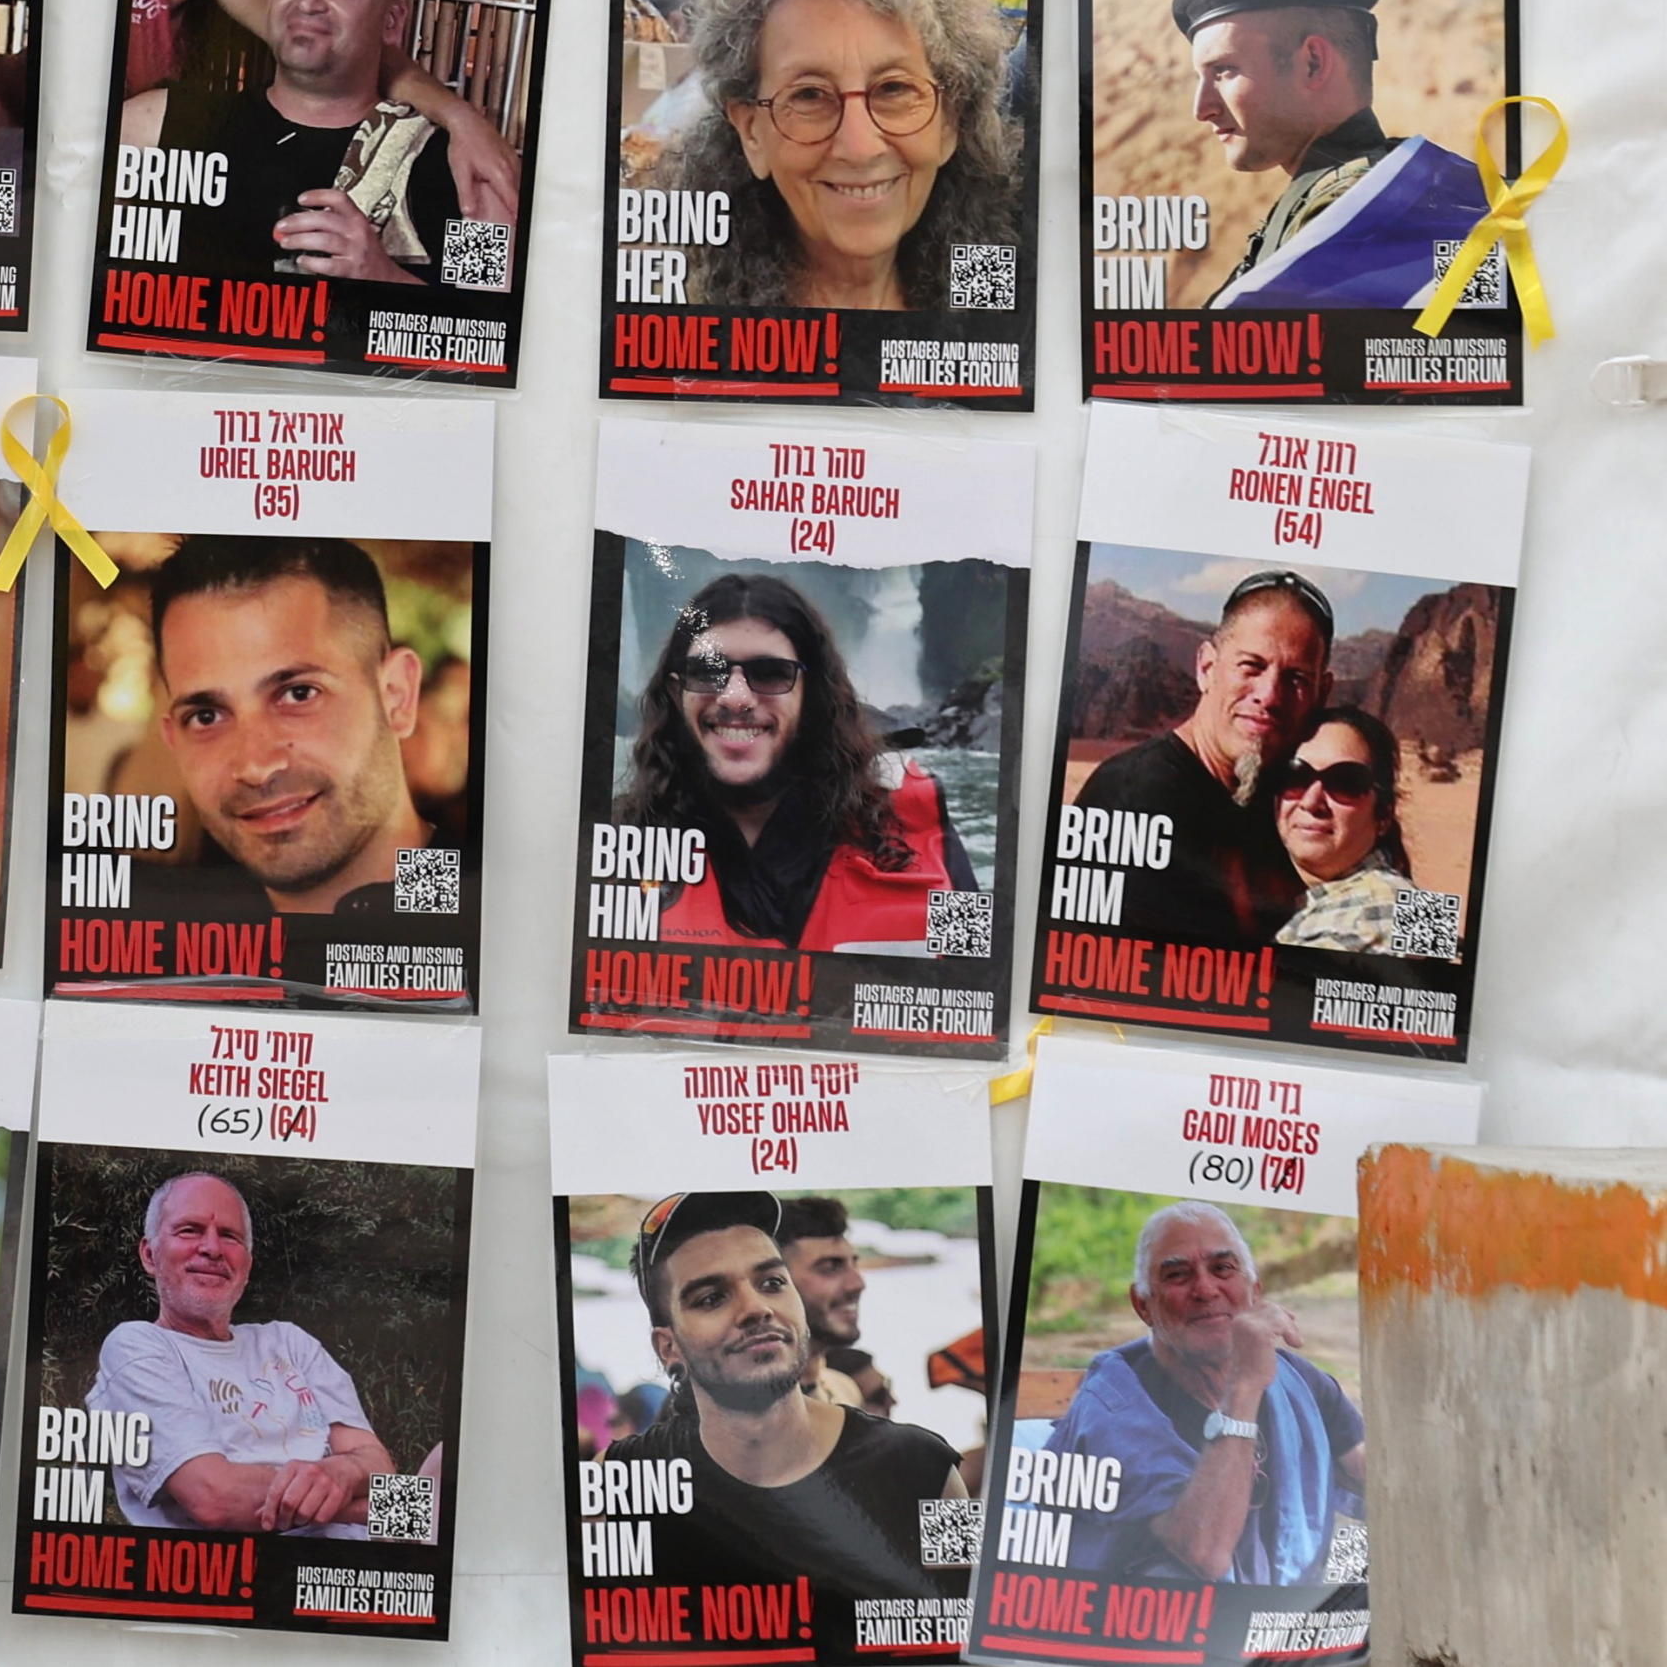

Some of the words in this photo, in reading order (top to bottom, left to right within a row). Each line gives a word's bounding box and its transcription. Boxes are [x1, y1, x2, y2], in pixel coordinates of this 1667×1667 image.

[617, 189, 730, 246] BRING
[616, 249, 687, 304] HER
[615, 313, 718, 371] HOME
[731, 312, 840, 375] NOW!
[213, 410, 262, 448] ברוך
[267, 409, 345, 449] אוריאל
[199, 446, 260, 480] URIEL
[266, 448, 357, 482] BARUCH
[730, 478, 806, 513] SAHAR
[811, 483, 901, 518] BARUCH
[1229, 468, 1304, 506] RONEN
[1308, 476, 1375, 514] ENGEL
[189, 1064, 252, 1097] KEITH
[257, 1067, 330, 1102] SIEGEL
[198, 1104, 263, 1141] (65)
[697, 1102, 766, 1135] YOSEF
[770, 1100, 850, 1134] OHANA
[1182, 1109, 1239, 1145] GADI
[1241, 1115, 1321, 1155] MOSES
[36, 1406, 150, 1467] BRING
[33, 1467, 104, 1524] HIM
[29, 1531, 136, 1591] HOME
[146, 1538, 256, 1599] NOW!
[297, 1566, 356, 1587] HOSTAGES
[357, 1569, 381, 1588] AND
[383, 1571, 434, 1591] MISSING
[296, 1584, 370, 1614] FAMILIES
[373, 1589, 434, 1618] FORUM
